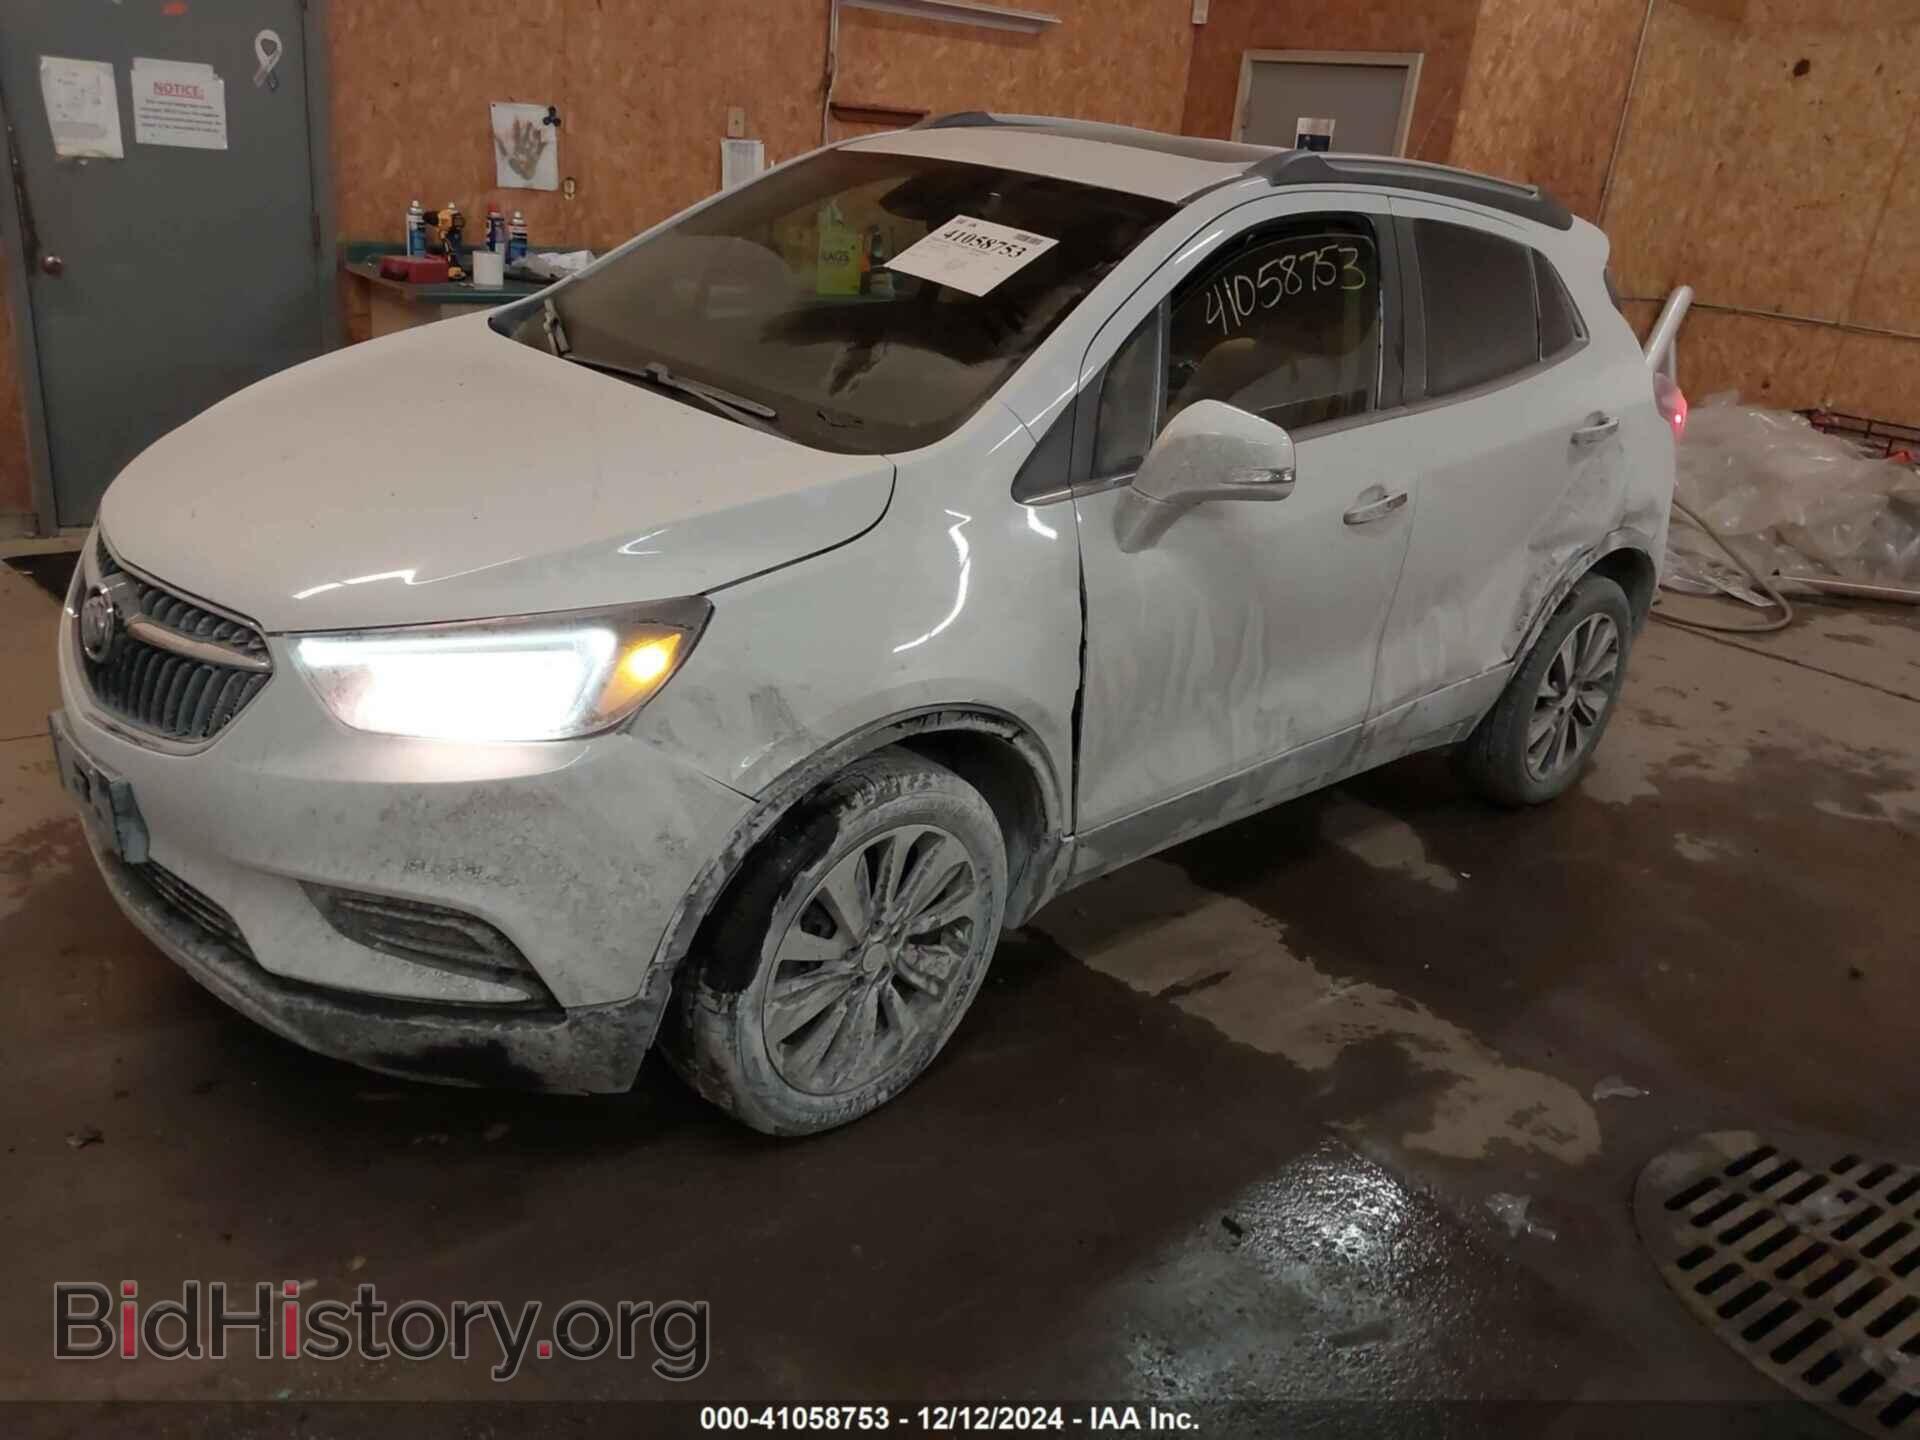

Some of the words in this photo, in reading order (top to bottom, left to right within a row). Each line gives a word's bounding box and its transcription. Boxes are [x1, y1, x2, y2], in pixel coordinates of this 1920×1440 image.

[153, 81, 205, 99] NOTICE:
[943, 229, 1027, 258] 41058753
[1206, 244, 1366, 336] 41058753
